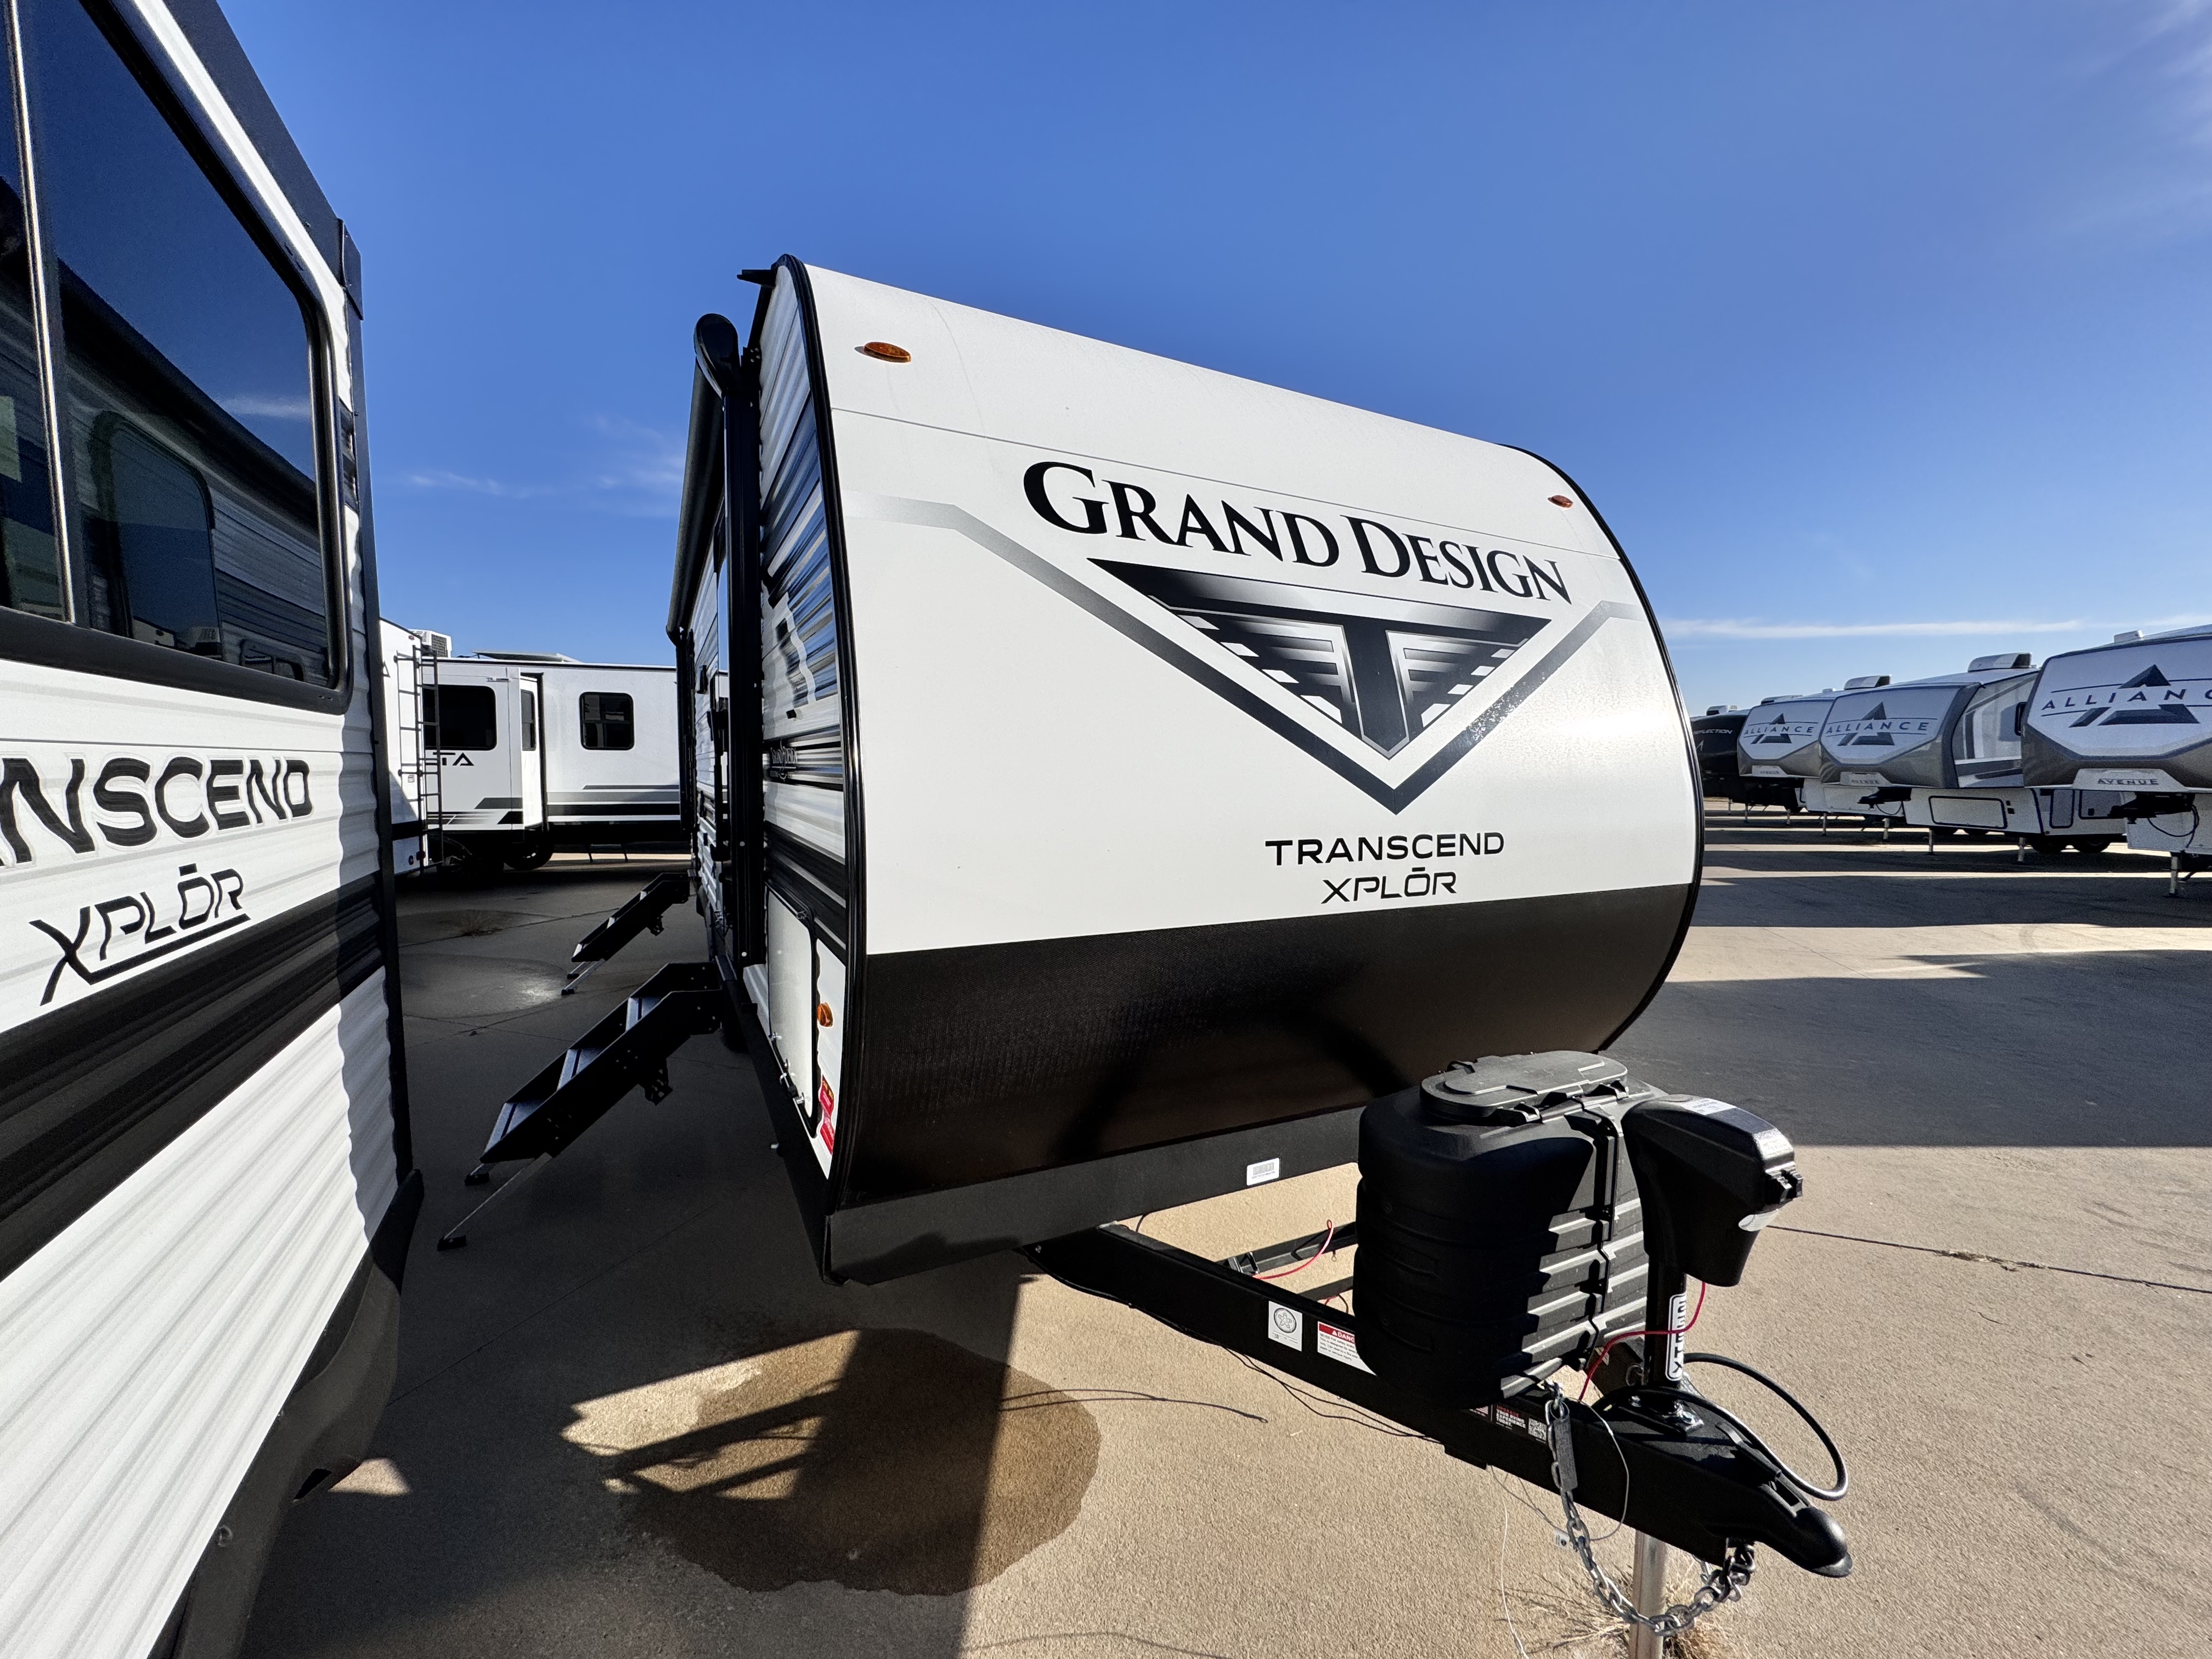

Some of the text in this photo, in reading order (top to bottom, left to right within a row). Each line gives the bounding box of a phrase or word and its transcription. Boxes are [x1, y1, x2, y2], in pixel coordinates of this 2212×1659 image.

[1024, 461, 1572, 605] GRAND DESIGN
[1744, 726, 1814, 736] ALLIANCE
[1826, 721, 1929, 734] ALLIANCE
[0, 757, 312, 866] NSCEND
[1266, 832, 1504, 866] TRANSCEND
[1496, 1409, 1509, 1418] YOUR
[1496, 1413, 1526, 1429] EXPERIENCE
